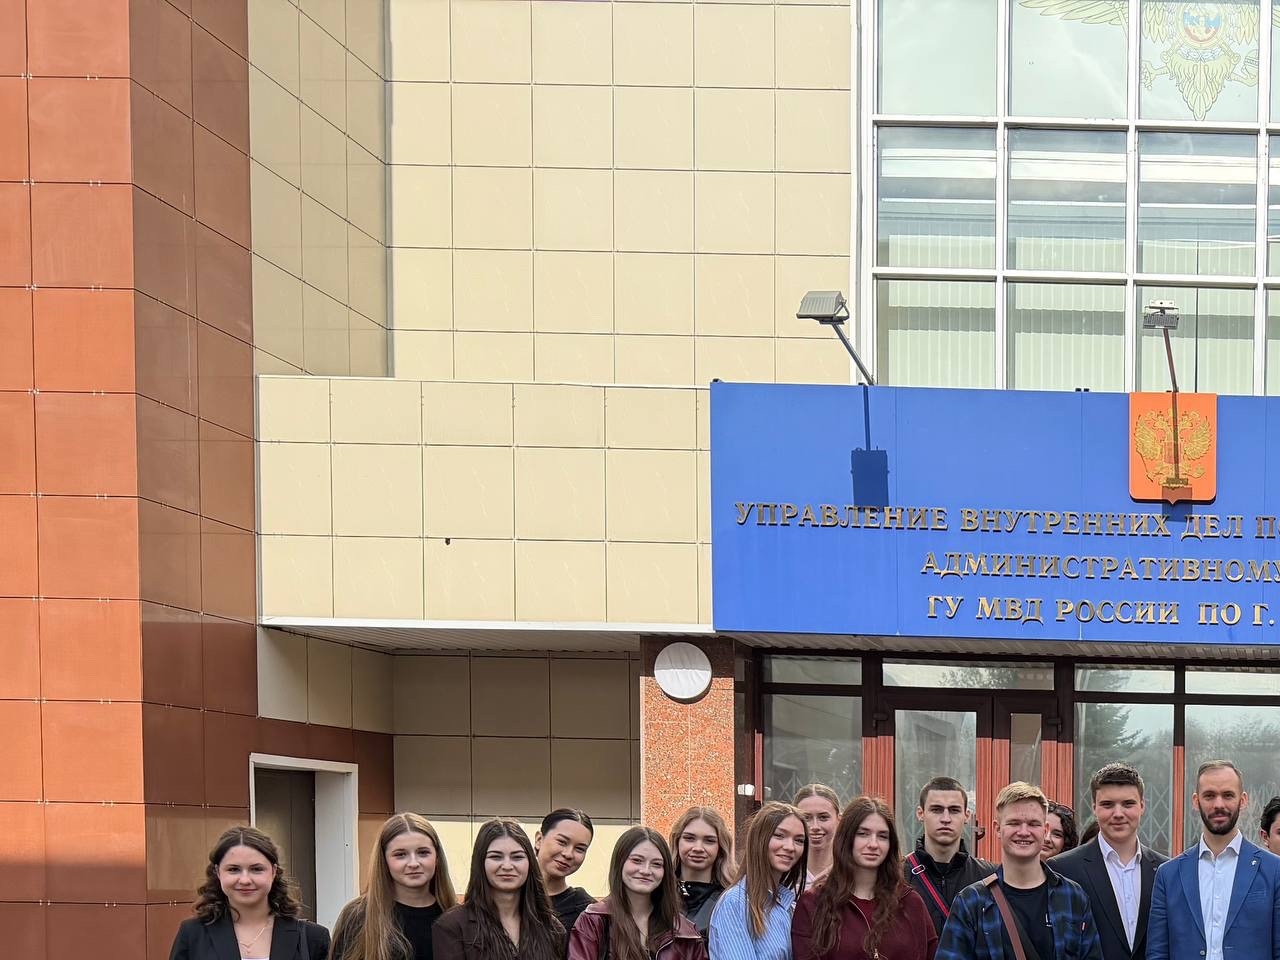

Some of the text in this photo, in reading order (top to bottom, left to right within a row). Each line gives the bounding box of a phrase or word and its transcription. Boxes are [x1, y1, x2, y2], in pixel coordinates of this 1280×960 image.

[734, 502, 948, 531] УПРАВЛЕНИЕ
[960, 508, 1171, 537] ВНУТРЕННИХ
[1180, 514, 1243, 540] ДЕЛ
[927, 595, 963, 619] ГУ
[975, 596, 1044, 625] МВД
[1055, 599, 1179, 625] РОССИИ
[1198, 603, 1242, 626] ПО
[1252, 604, 1274, 627] Г.
